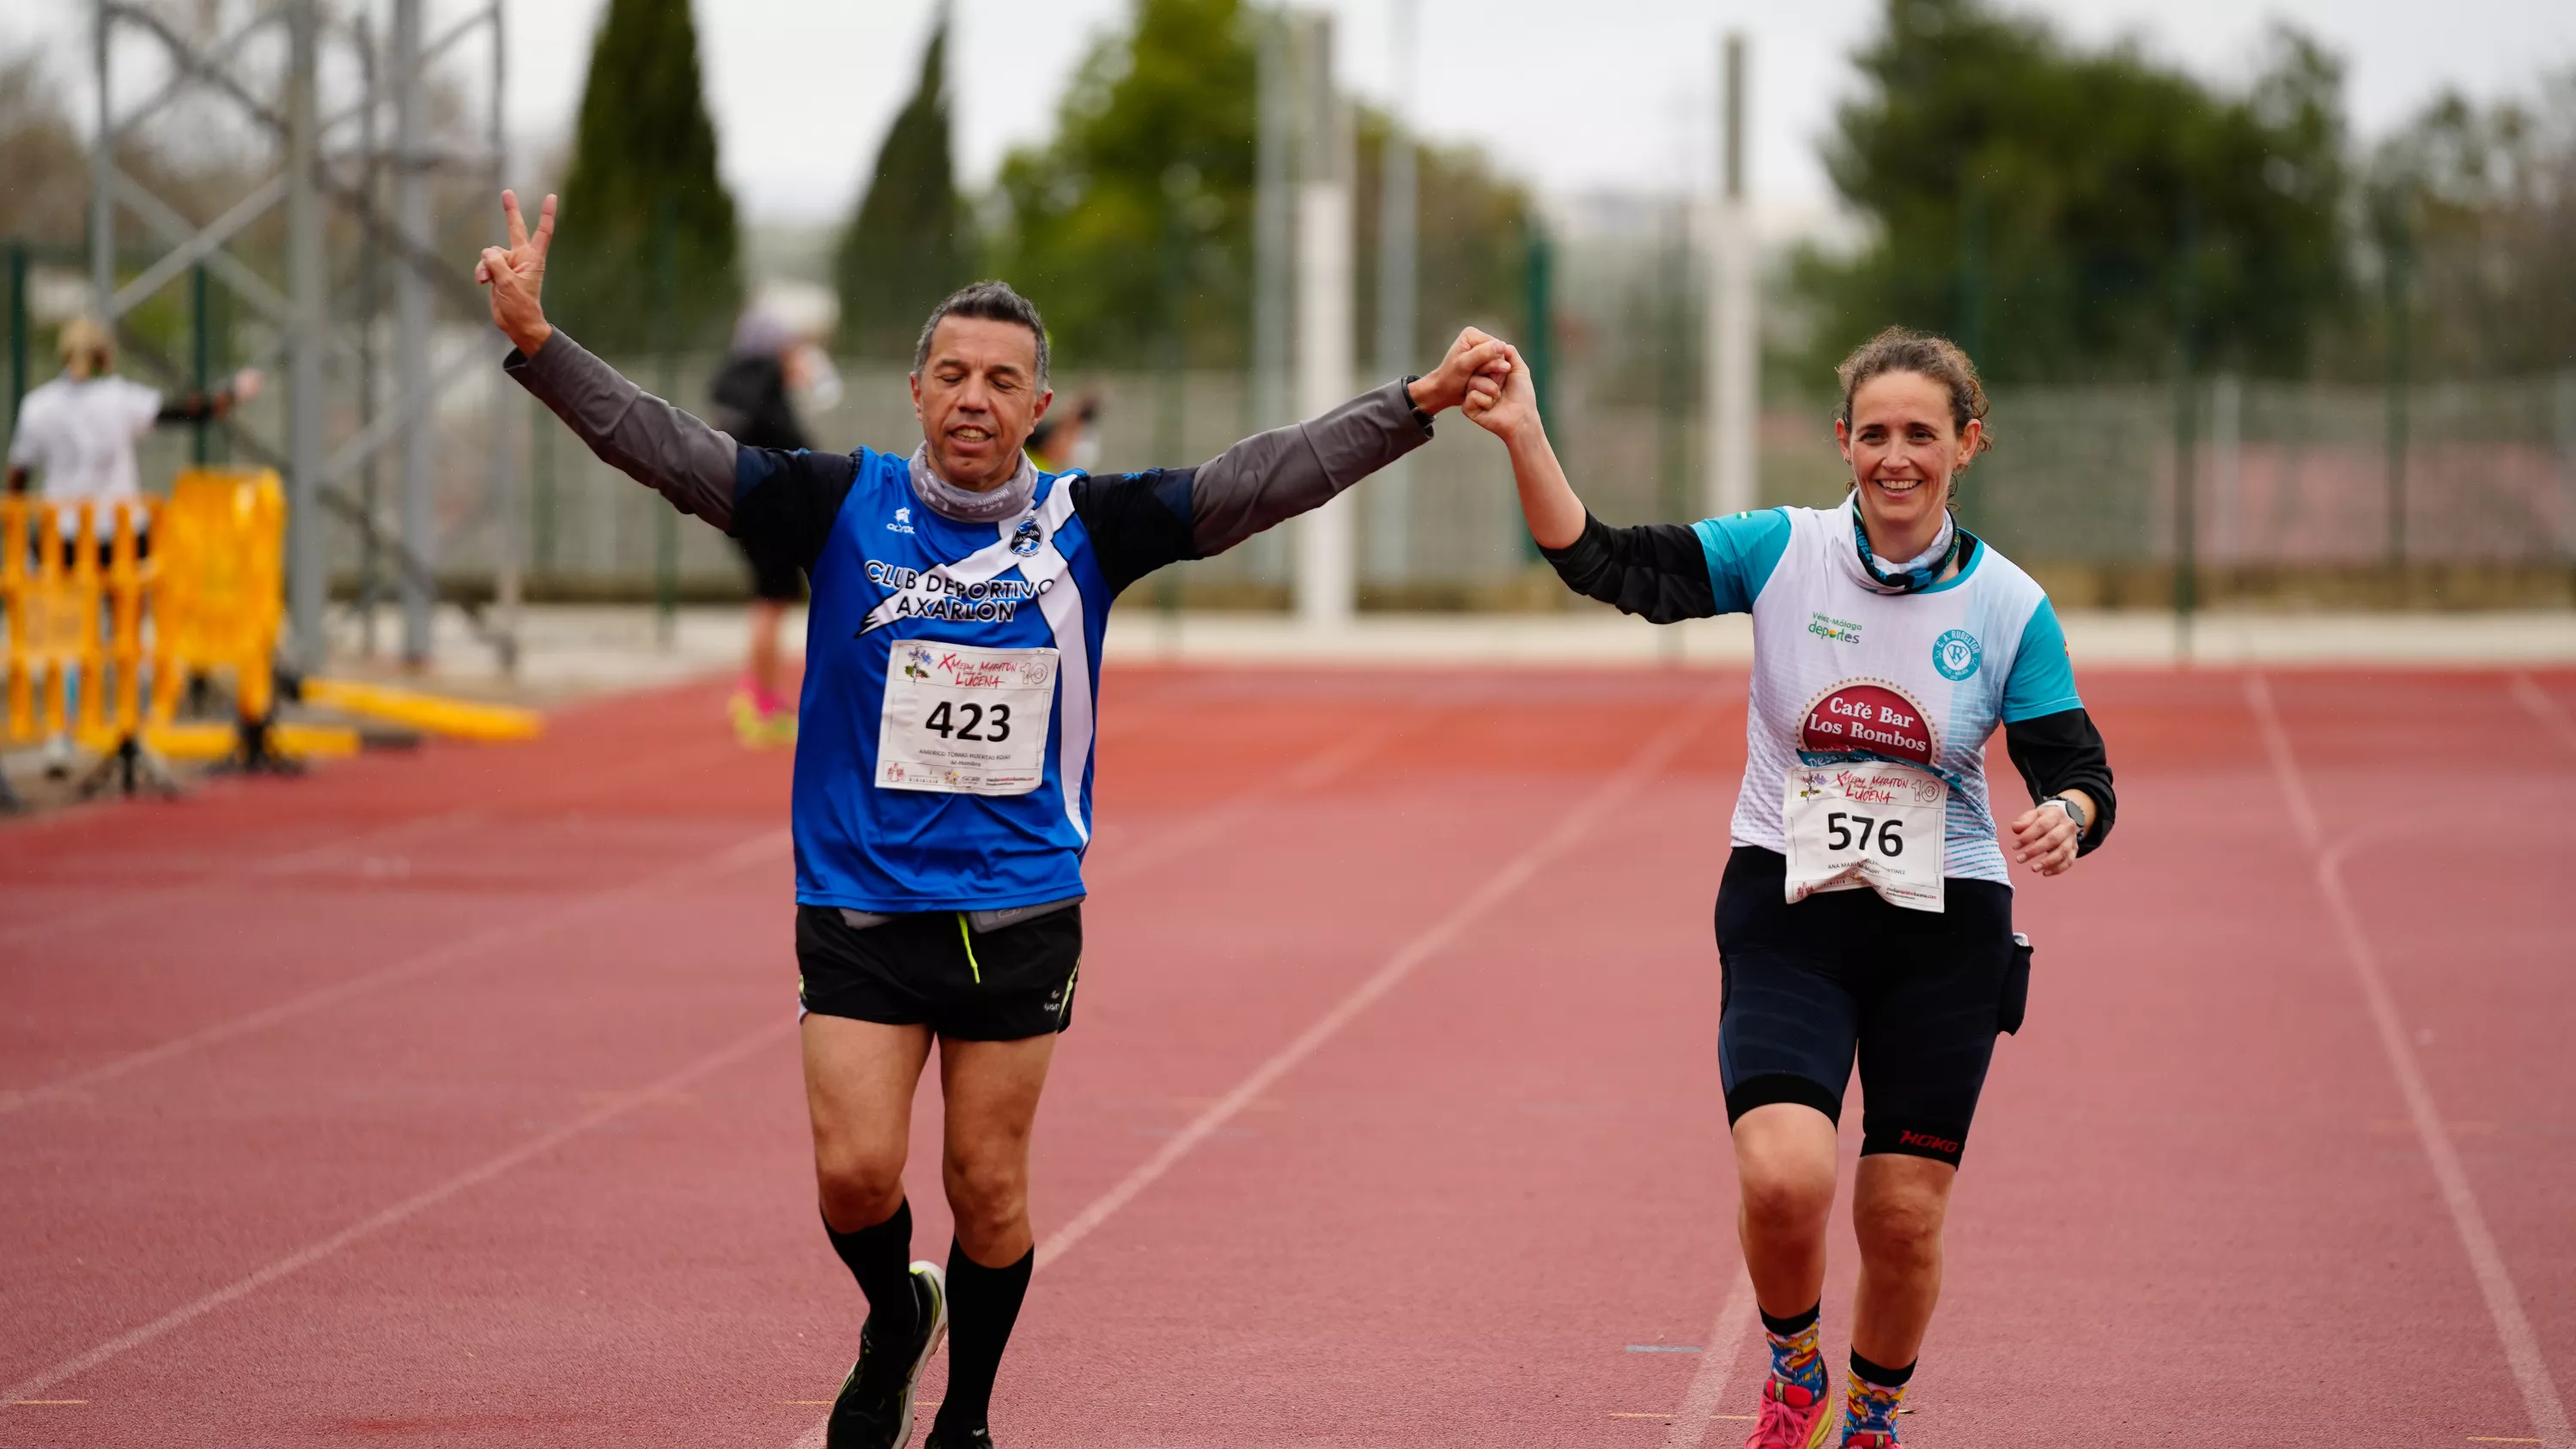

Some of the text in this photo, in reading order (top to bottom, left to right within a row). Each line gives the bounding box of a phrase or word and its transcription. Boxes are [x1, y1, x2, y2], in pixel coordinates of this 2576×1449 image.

[866, 561, 1055, 599] CLUB DEPORTIVO
[896, 596, 1017, 621] AXARLÓN
[1808, 621, 1860, 644] deportes
[1813, 611, 1862, 631] Vélez-Málaga
[938, 653, 957, 674] X
[955, 671, 1005, 689] LUCENA
[926, 700, 1011, 743] 423
[1830, 696, 1914, 728] Café Bar
[1809, 712, 1926, 752] Los Rombos
[1845, 784, 1898, 804] LUCENA
[1828, 812, 1903, 857] 576
[1899, 1129, 1959, 1153] HOKO
